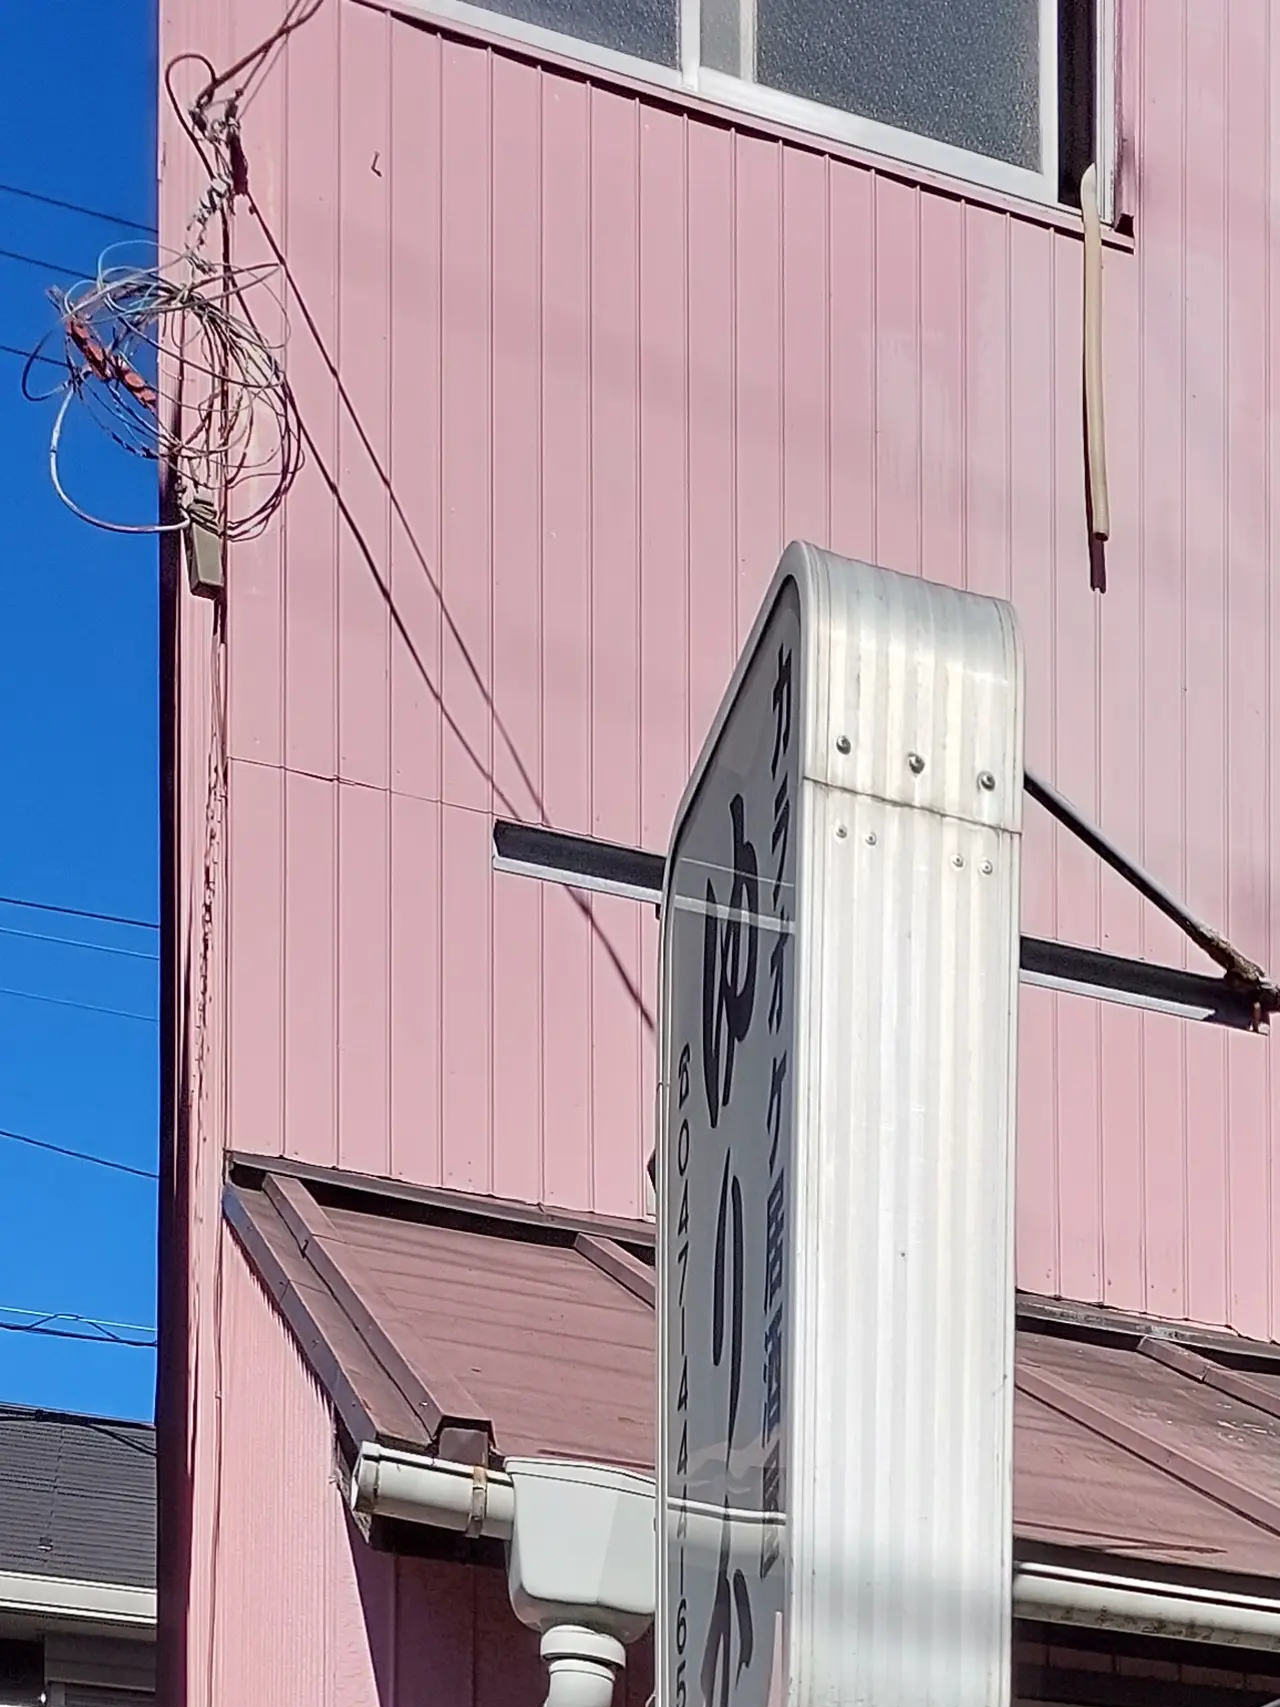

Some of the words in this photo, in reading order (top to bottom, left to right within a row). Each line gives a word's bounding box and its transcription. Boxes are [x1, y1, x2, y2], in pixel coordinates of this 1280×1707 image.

[761, 643, 793, 1581] カラオケ居酒屋
